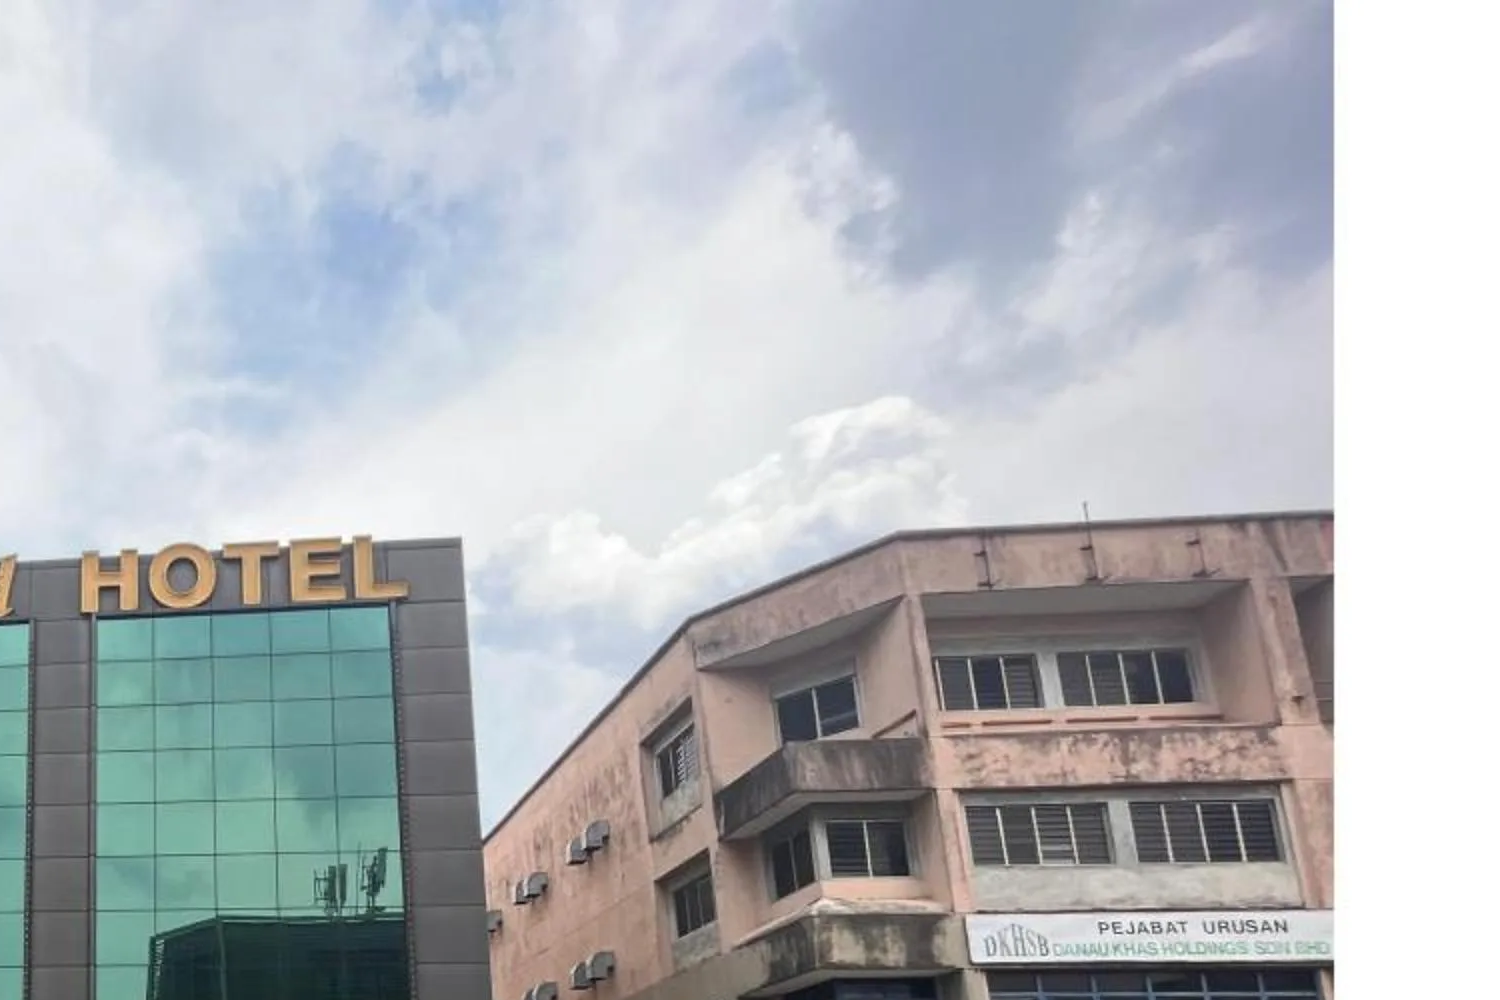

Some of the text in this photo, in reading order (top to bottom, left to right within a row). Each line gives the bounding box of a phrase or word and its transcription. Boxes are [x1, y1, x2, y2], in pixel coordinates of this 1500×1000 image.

[79, 534, 410, 613] HOTEL
[1098, 919, 1289, 935] PEJABAT URUSAN
[984, 923, 1049, 957] DKHSB
[1053, 942, 1109, 957] DANAU
[1111, 941, 1160, 956] KHAS
[1162, 940, 1249, 956] HOLDINGS
[1253, 941, 1291, 956] SDN
